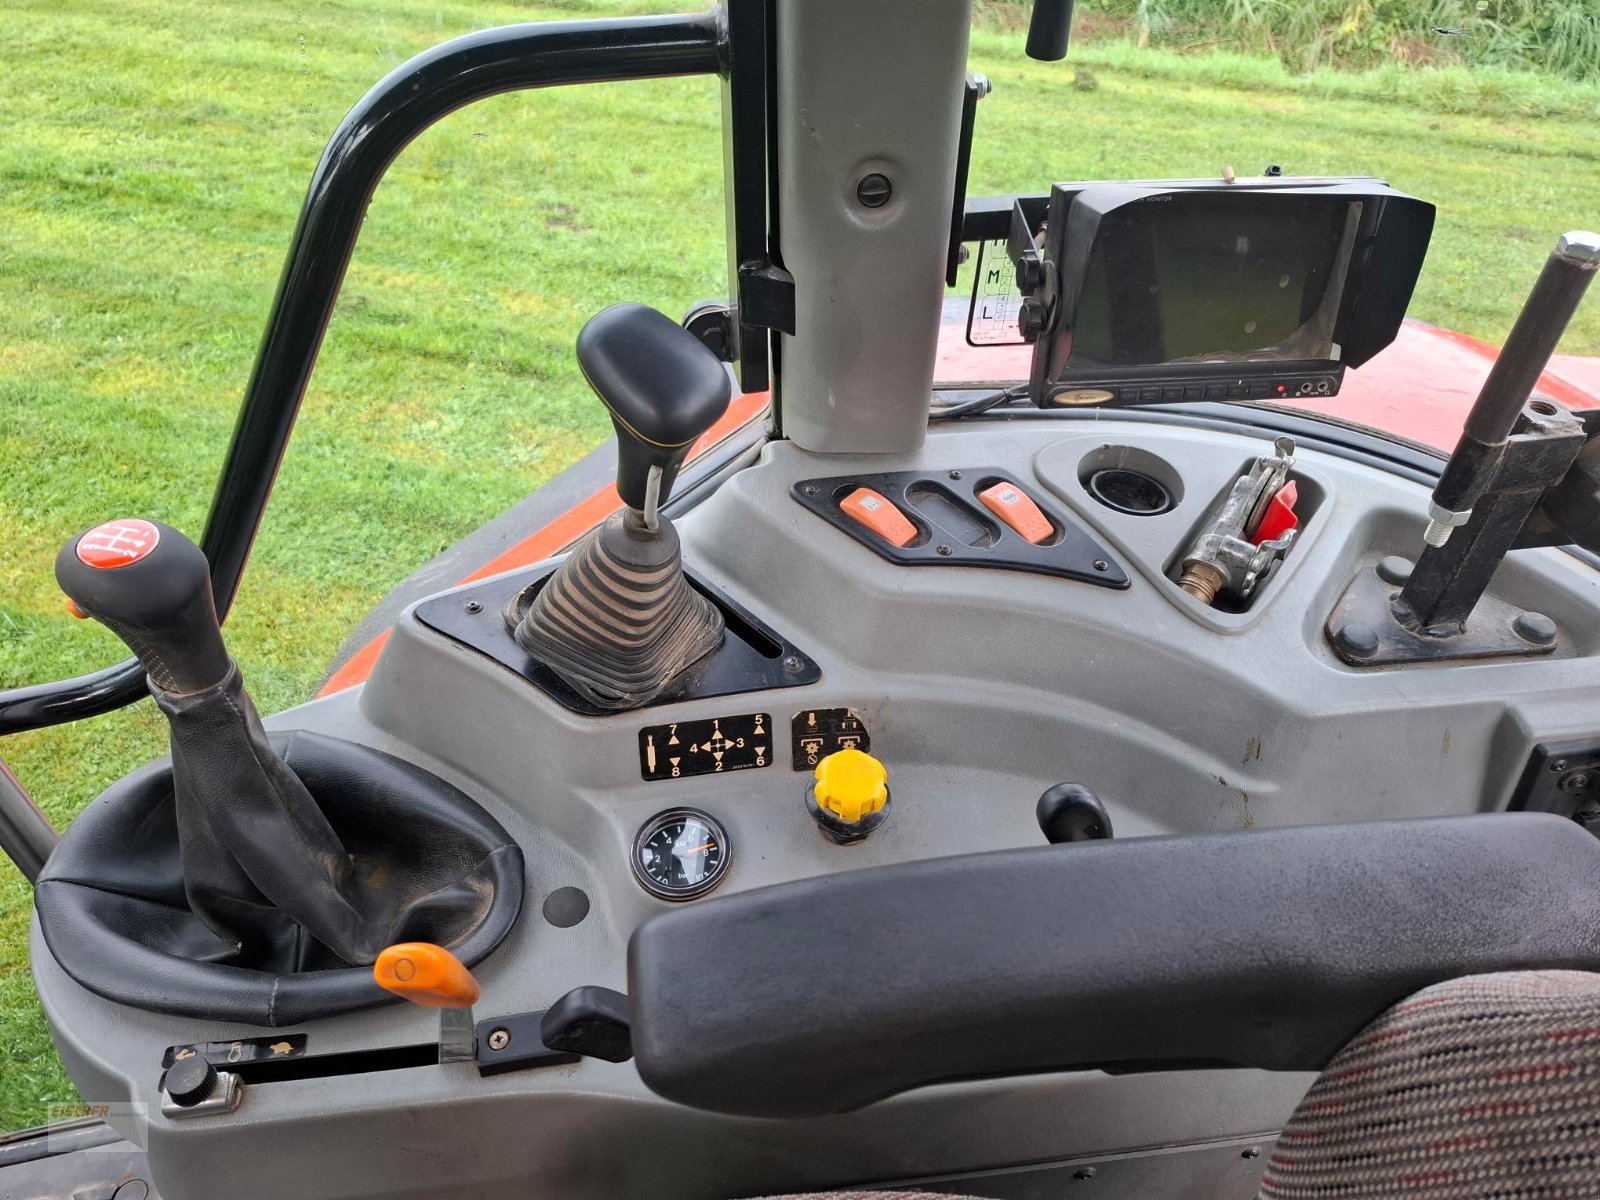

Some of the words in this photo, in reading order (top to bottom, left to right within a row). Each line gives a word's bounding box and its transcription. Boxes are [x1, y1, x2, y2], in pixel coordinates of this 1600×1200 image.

[988, 270, 1000, 284] M
[982, 306, 992, 319] L
[123, 549, 138, 558] 2
[755, 714, 763, 724] 5
[670, 724, 678, 735] 7
[713, 720, 718, 730] 1
[736, 738, 744, 748] 3
[690, 744, 698, 754] 4
[756, 756, 764, 766] 6
[672, 767, 680, 777] 8
[716, 762, 723, 772] 2
[666, 836, 672, 844] 4
[704, 848, 708, 856] 8
[654, 854, 660, 862] 2
